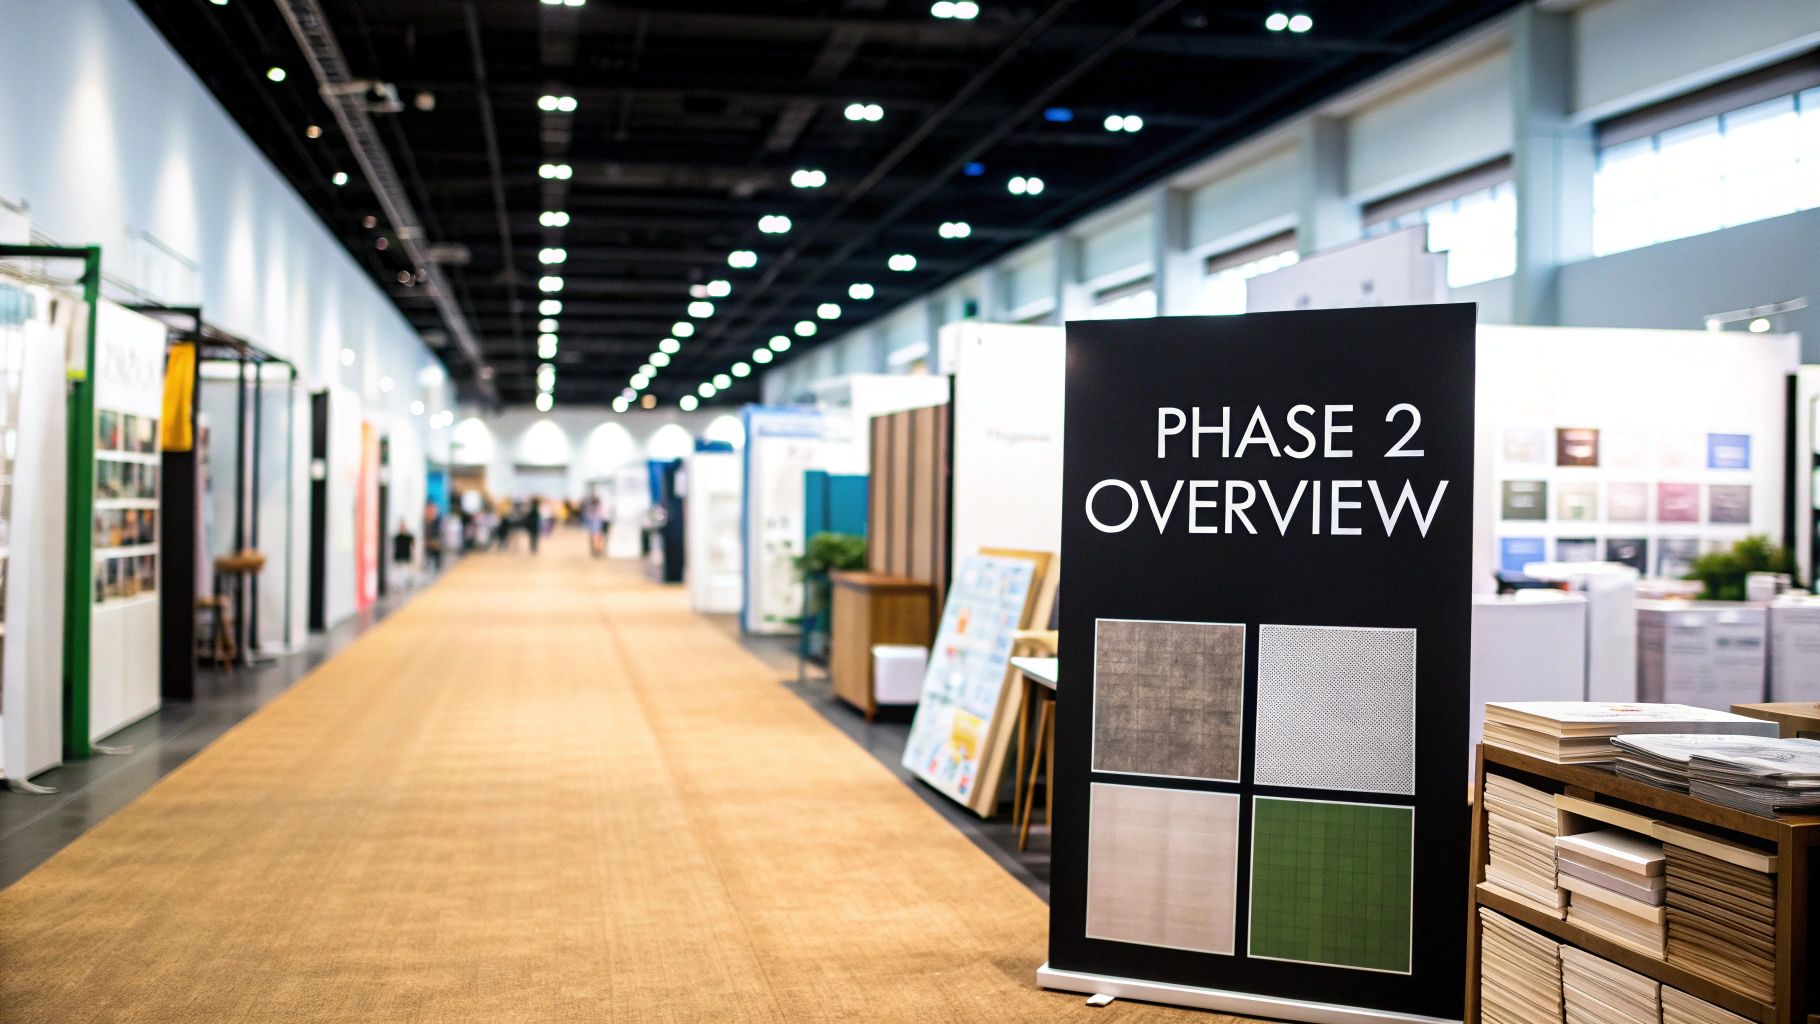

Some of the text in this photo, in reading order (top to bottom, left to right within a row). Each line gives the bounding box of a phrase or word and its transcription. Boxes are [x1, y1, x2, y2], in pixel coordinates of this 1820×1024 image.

[1157, 402, 1425, 459] PHASE 2
[1084, 478, 1450, 539] OVERVIEW
